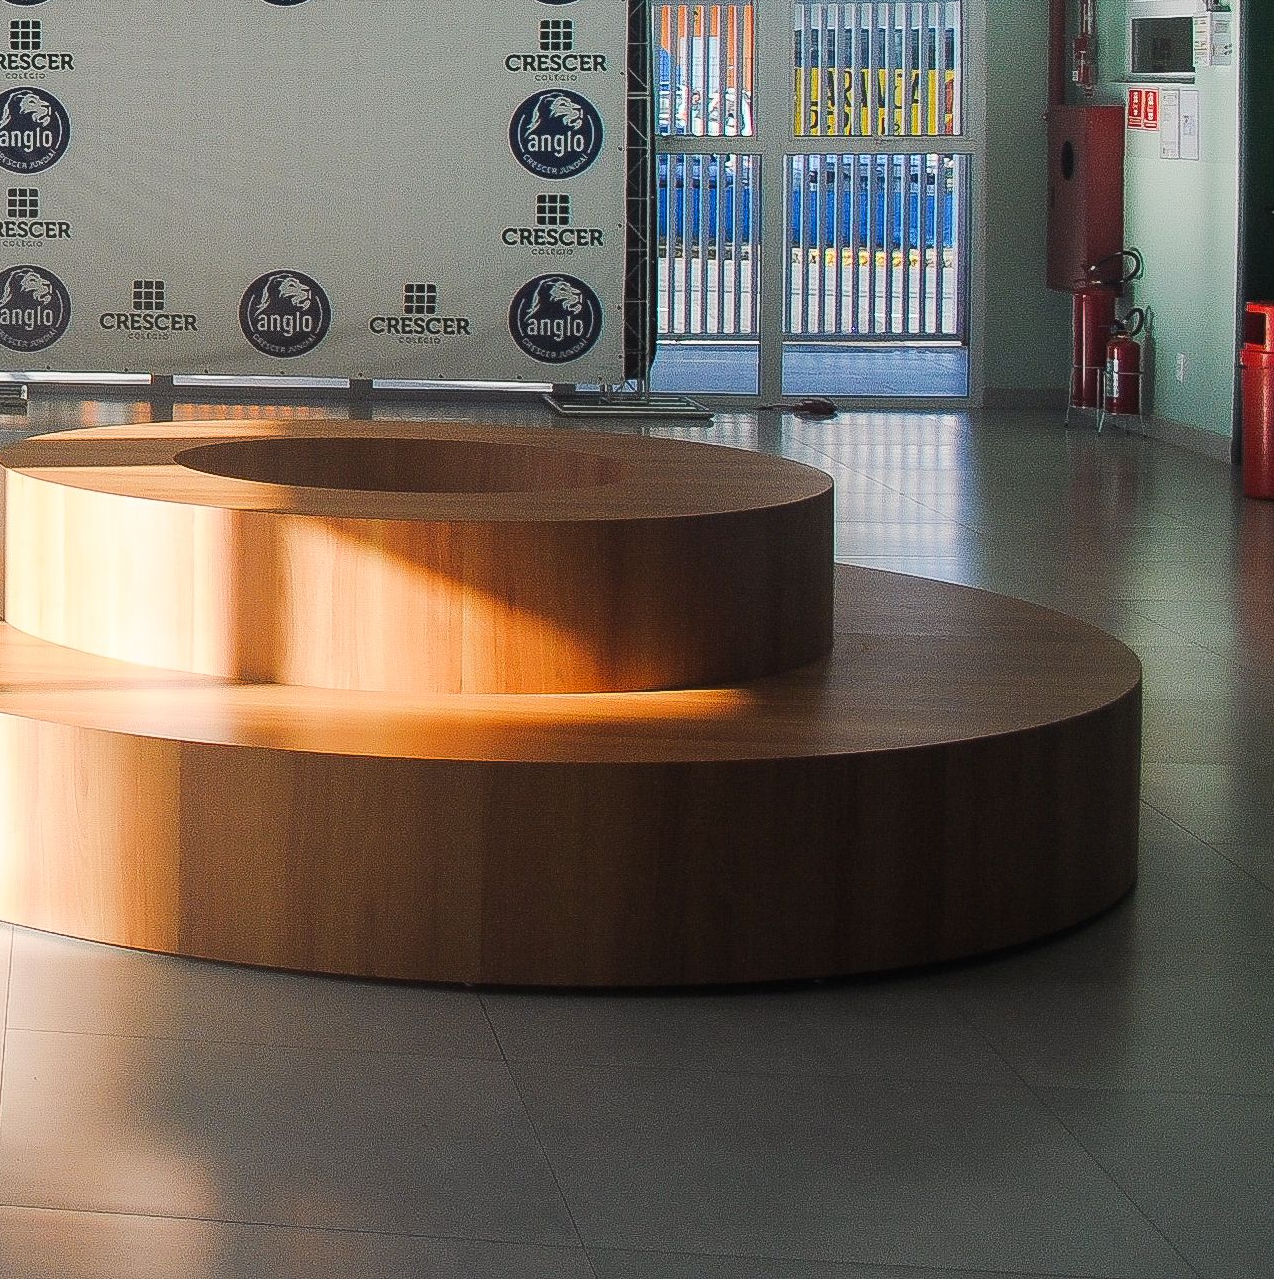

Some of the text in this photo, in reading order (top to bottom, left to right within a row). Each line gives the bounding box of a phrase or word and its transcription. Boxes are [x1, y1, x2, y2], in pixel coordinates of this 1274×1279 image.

[504, 54, 607, 72] CRESCER
[0, 127, 53, 153] anglo
[528, 131, 584, 158] anglo
[523, 154, 558, 174] CRESCER
[502, 228, 604, 246] CRESCER
[0, 306, 53, 330] anglo
[99, 313, 198, 331] CRESCER
[257, 311, 312, 336] anglo
[369, 316, 470, 335] CRESCER
[527, 315, 584, 341] anglo
